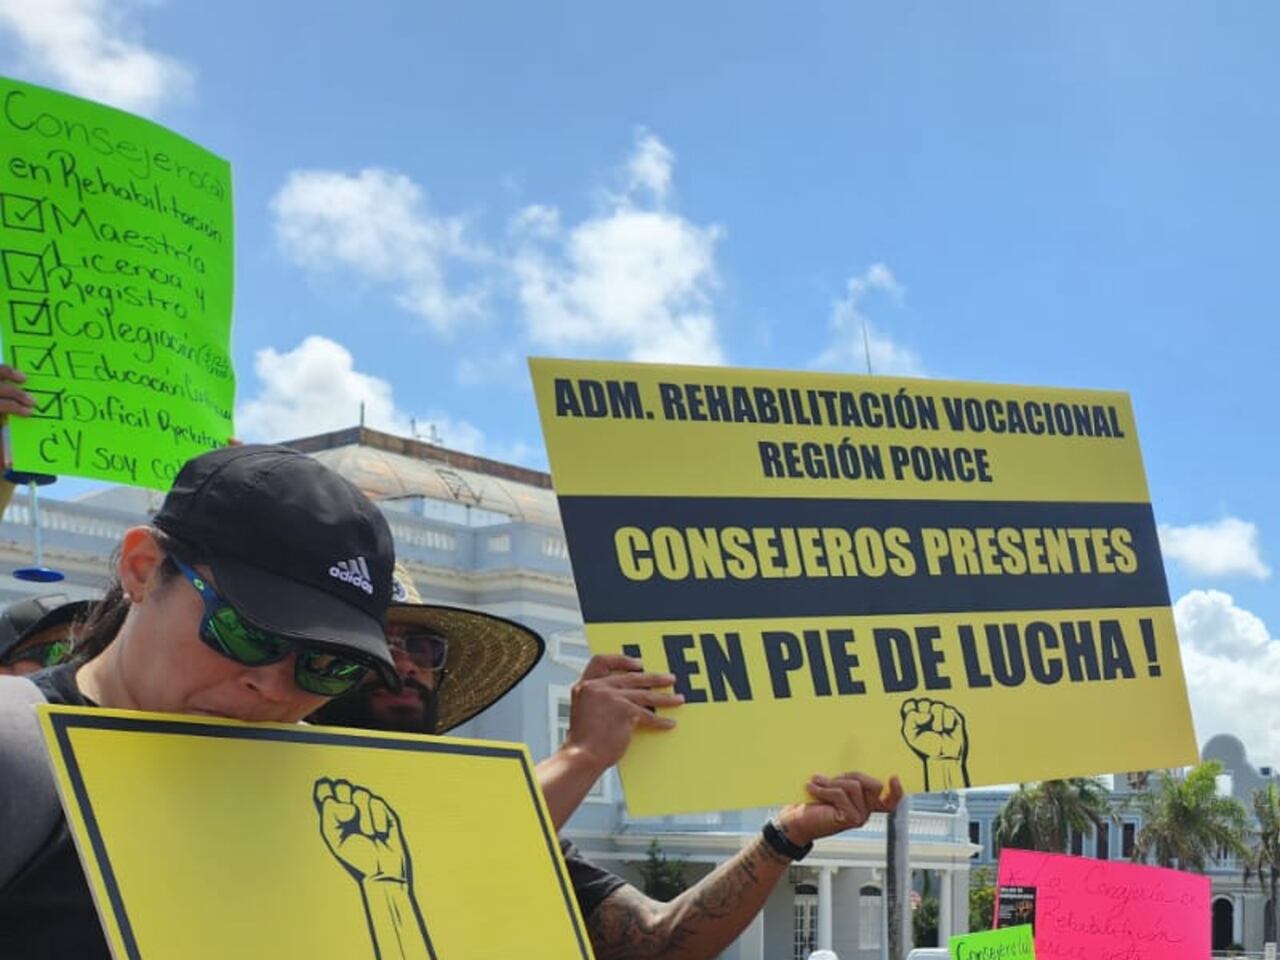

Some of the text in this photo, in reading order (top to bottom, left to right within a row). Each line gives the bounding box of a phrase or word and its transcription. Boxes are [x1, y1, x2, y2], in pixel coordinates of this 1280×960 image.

[10, 157, 51, 184] en
[52, 203, 206, 274] Maestría
[554, 377, 1125, 440] ADM. REHABILITACIÓN VOCACIONAL
[758, 436, 993, 484] REGIÓN PONCE
[329, 565, 374, 595] adidas
[614, 525, 1139, 582] CONSEJEROS PRESENTES
[662, 633, 753, 703] EN
[761, 628, 867, 699] PIE
[872, 624, 952, 693] DE
